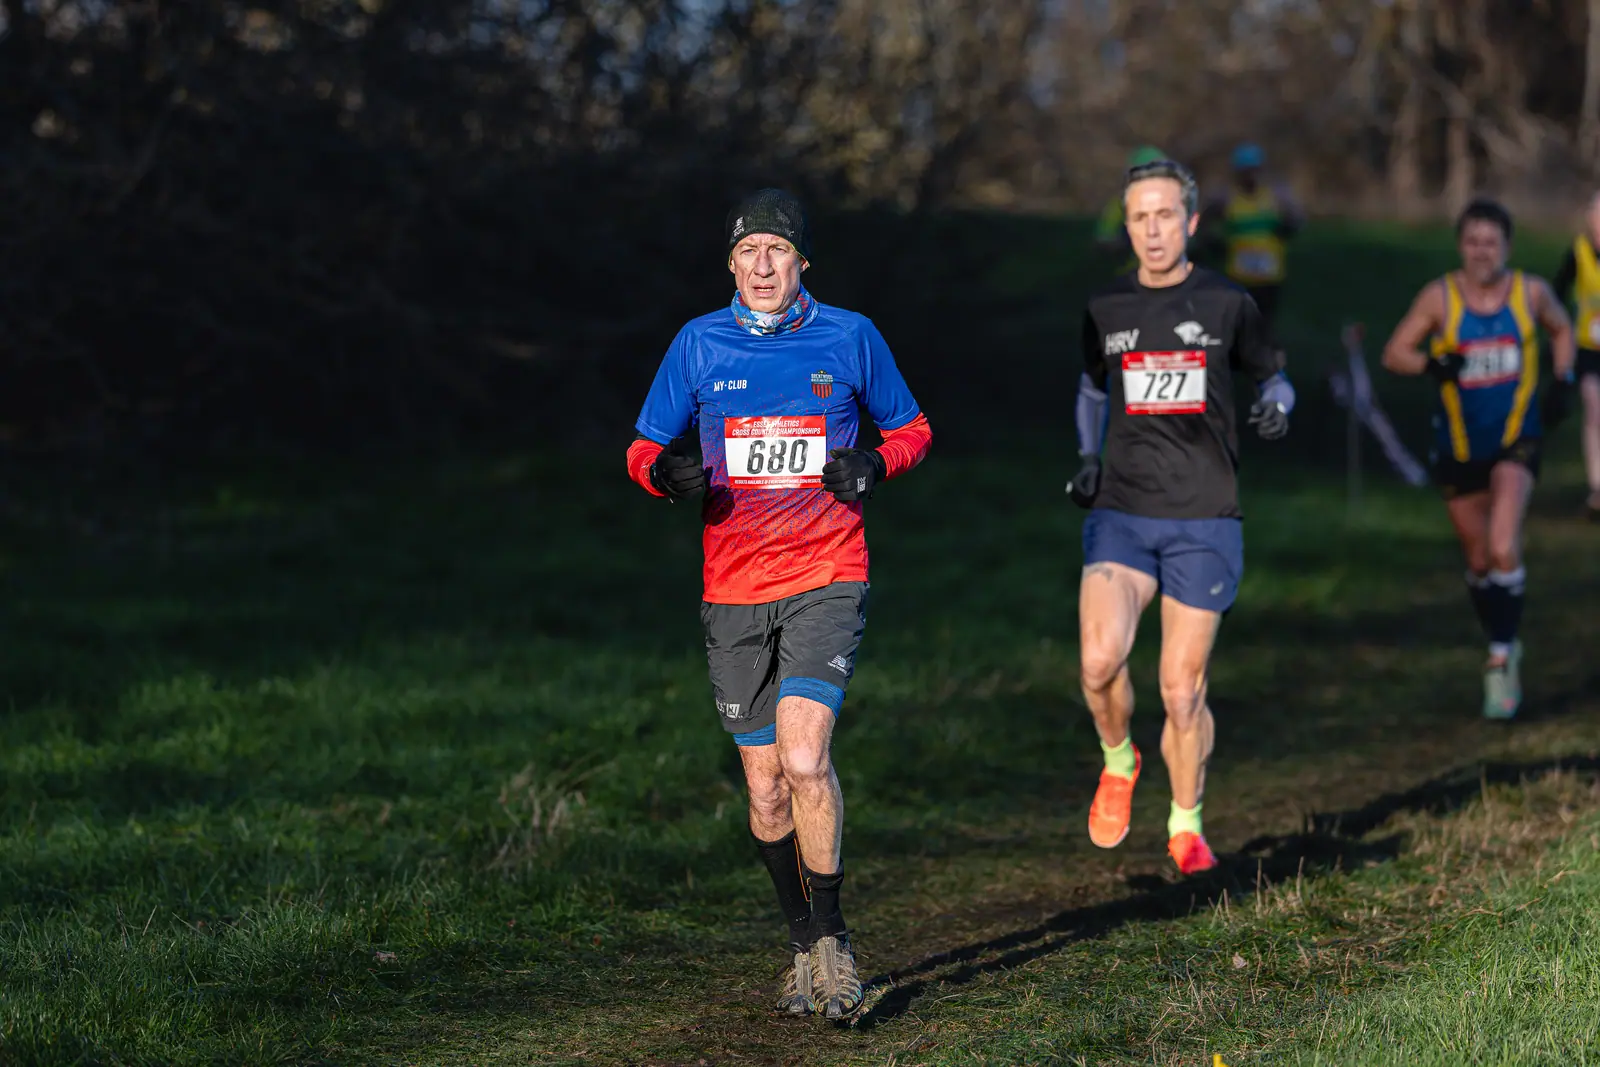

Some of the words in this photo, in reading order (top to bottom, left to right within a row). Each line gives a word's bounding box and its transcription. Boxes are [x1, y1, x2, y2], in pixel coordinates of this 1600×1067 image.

[1105, 328, 1140, 355] HRV
[1143, 372, 1189, 400] 727
[732, 428, 750, 436] CROSS
[776, 427, 821, 435] CHAMPIONSHIPS
[753, 420, 769, 428] ESSE
[746, 439, 809, 474] 680
